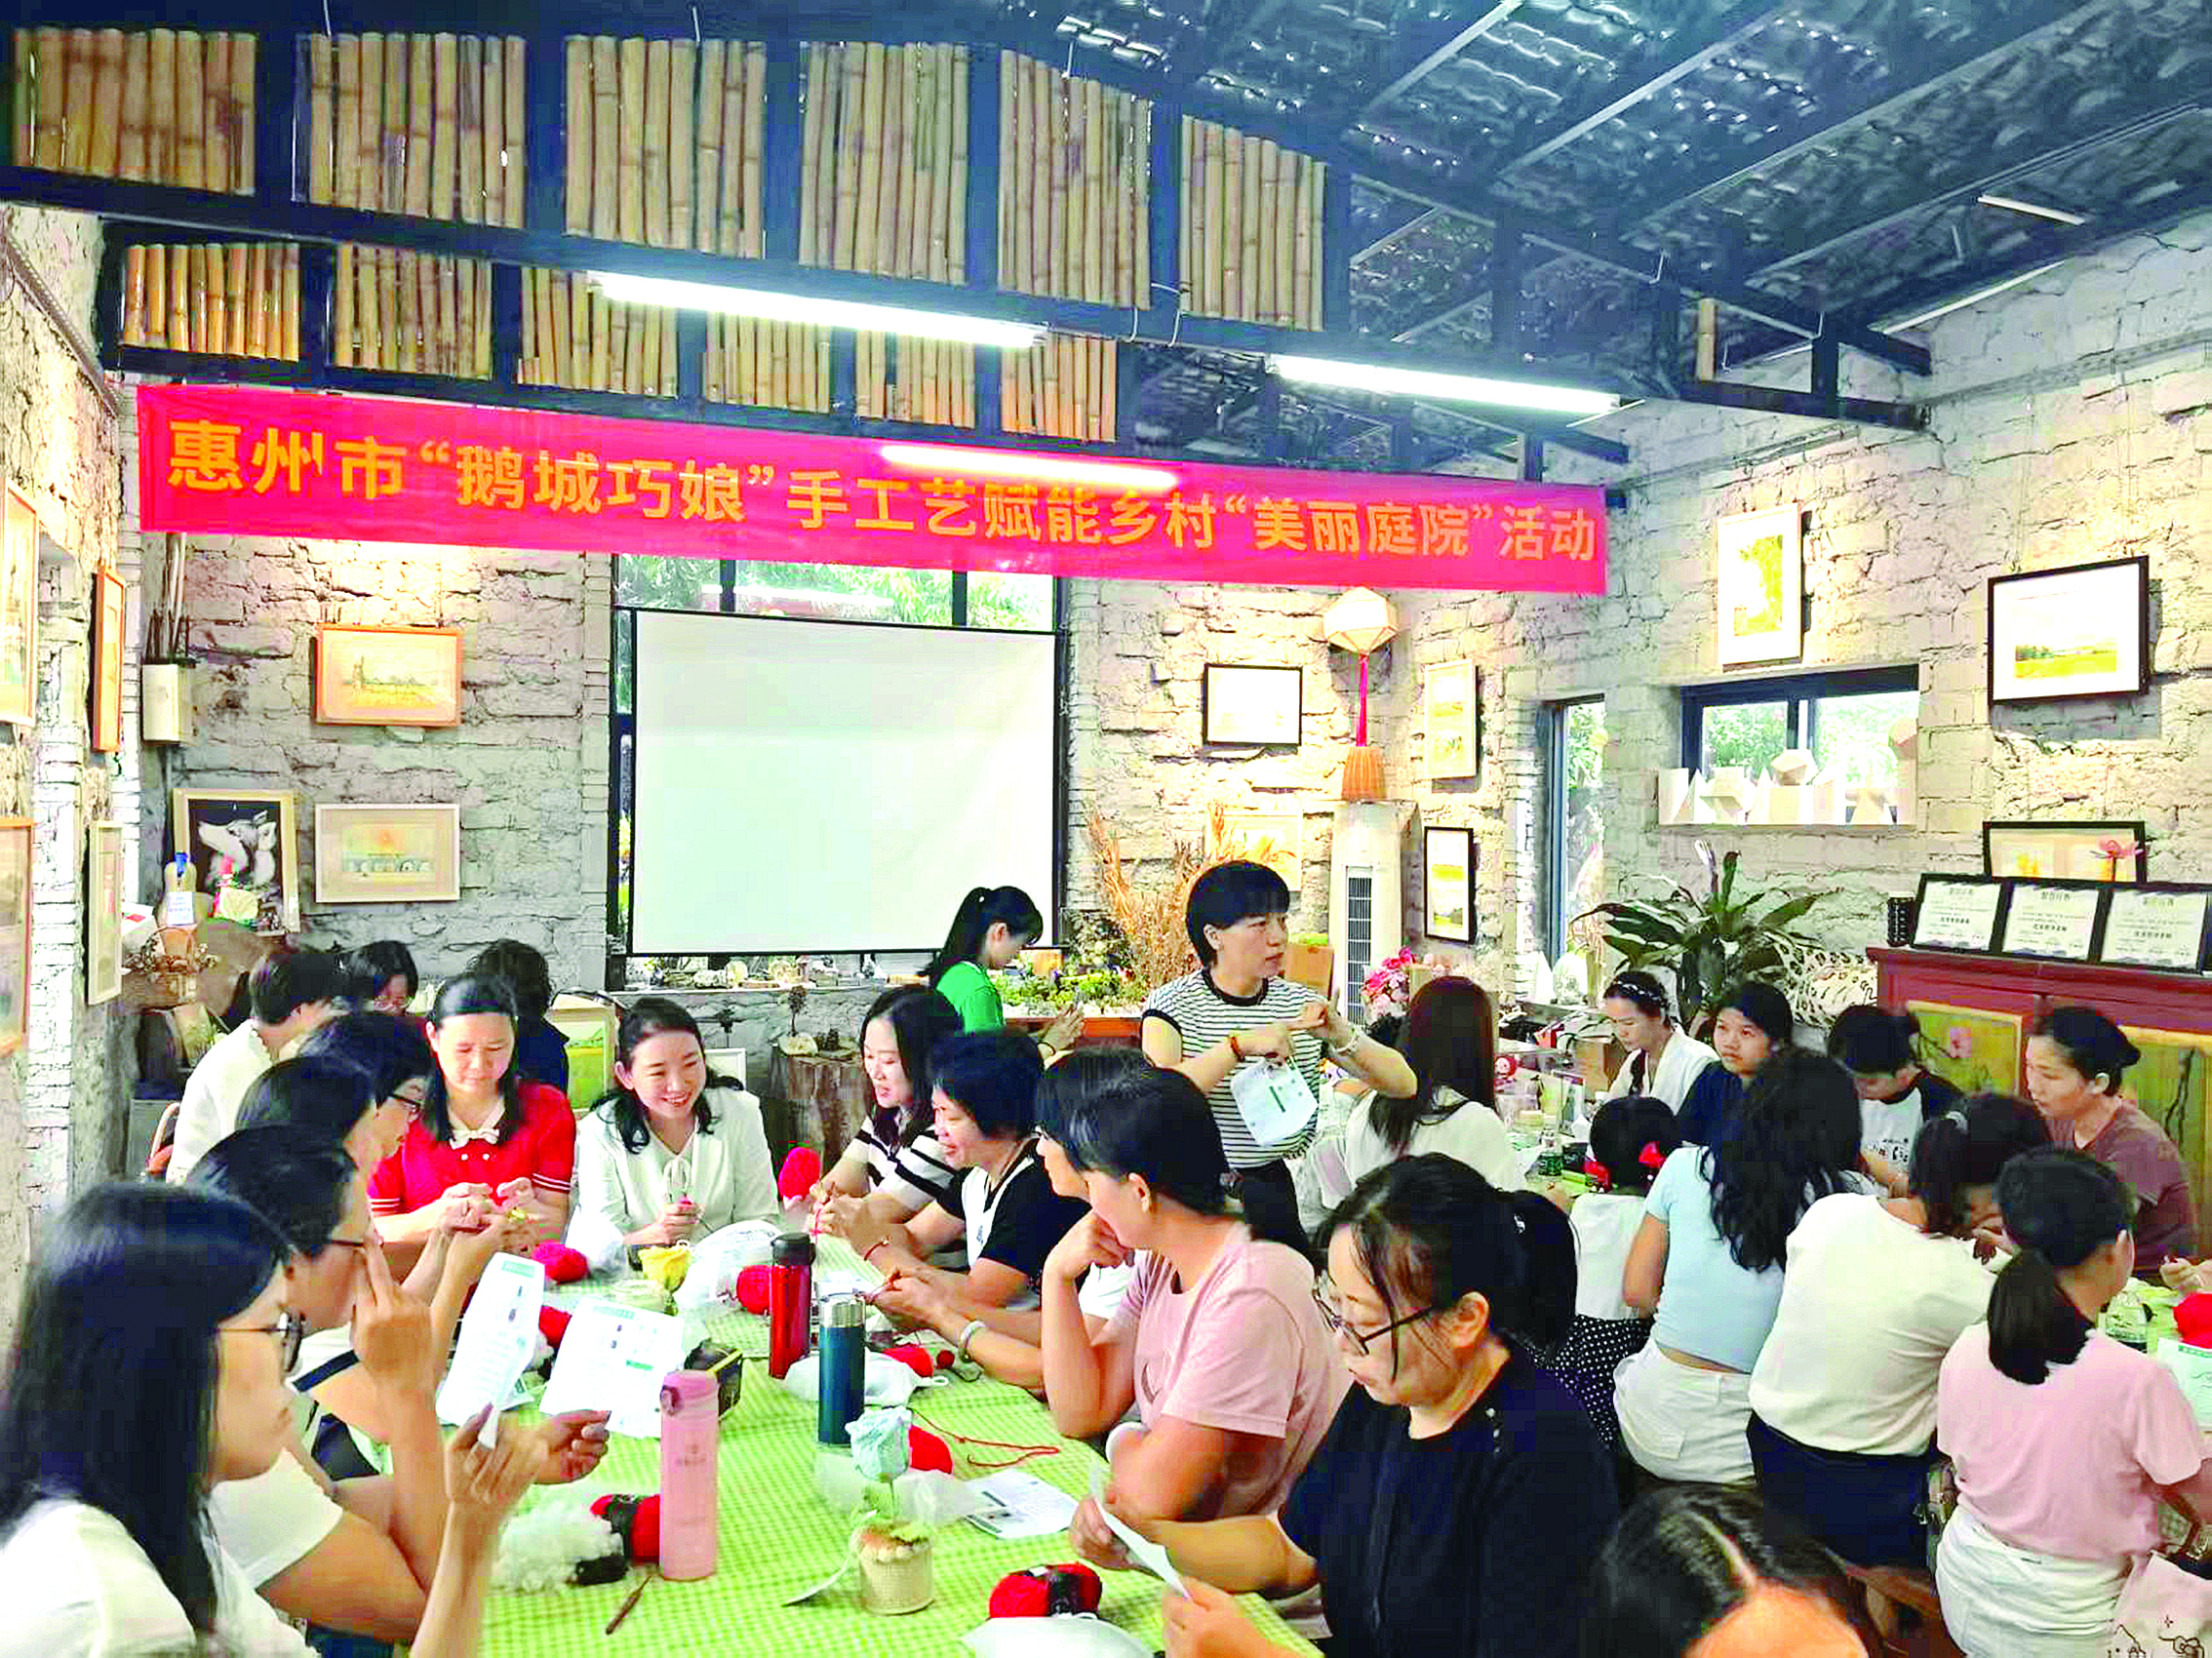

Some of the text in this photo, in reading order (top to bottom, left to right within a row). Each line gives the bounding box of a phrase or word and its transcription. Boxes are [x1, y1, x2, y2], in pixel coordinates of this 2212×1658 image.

[168, 420, 1597, 561] 惠州市“鹅城巧娘”手工艺赋能乡村“美丽庭院”活动
